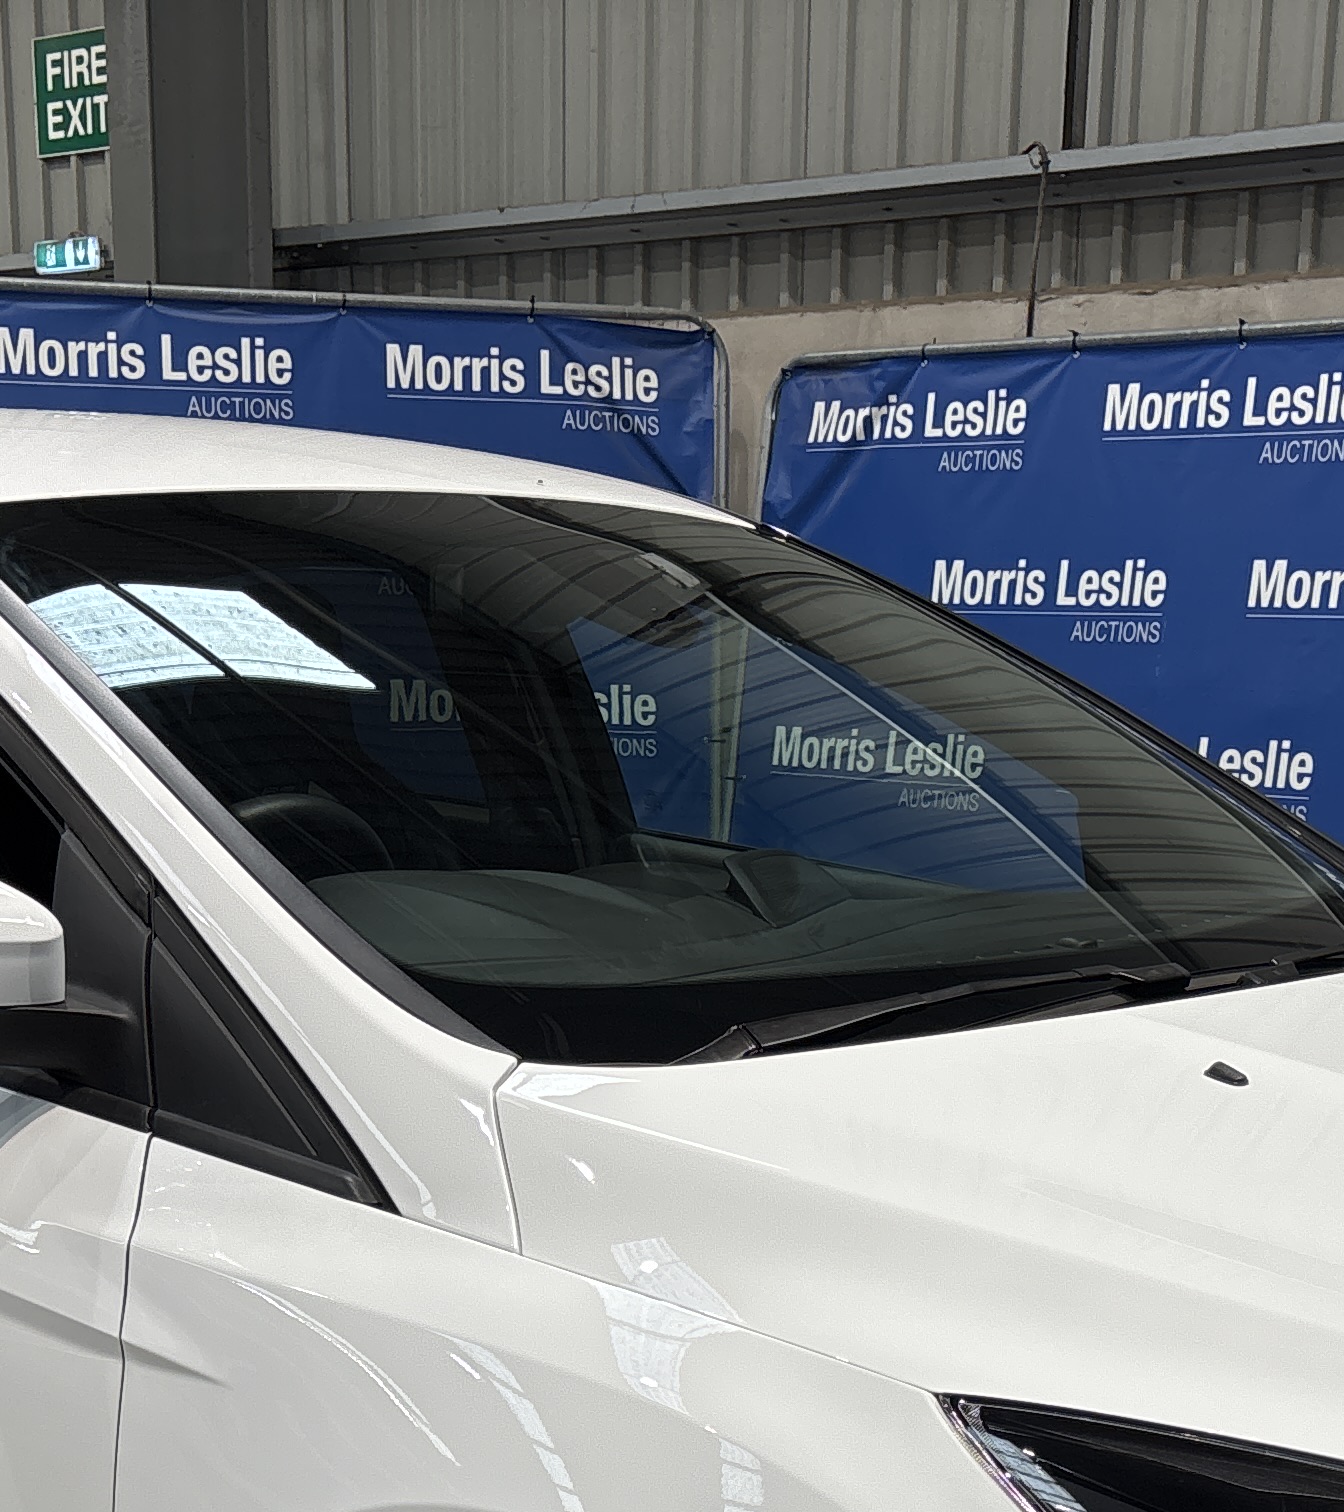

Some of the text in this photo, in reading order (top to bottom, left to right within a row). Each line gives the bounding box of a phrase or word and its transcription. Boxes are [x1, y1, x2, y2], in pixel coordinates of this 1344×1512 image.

[46, 45, 107, 91] FIRE
[47, 95, 108, 140] EXIT
[161, 334, 292, 384] Leslie
[386, 344, 658, 402] Morris Leslie
[188, 396, 293, 419] AUCTIONS
[562, 409, 659, 435] AUCTIONS
[808, 389, 1026, 443] Morris Leslie
[1104, 379, 1230, 431] Morris
[938, 449, 1022, 471] AUCTIONS
[932, 559, 1166, 607] Morris Leslie
[1070, 621, 1160, 643] AUCTIONS
[772, 726, 985, 780] Morris Leslie
[1199, 737, 1313, 790] eslie
[898, 787, 980, 812] AUCTIONS
